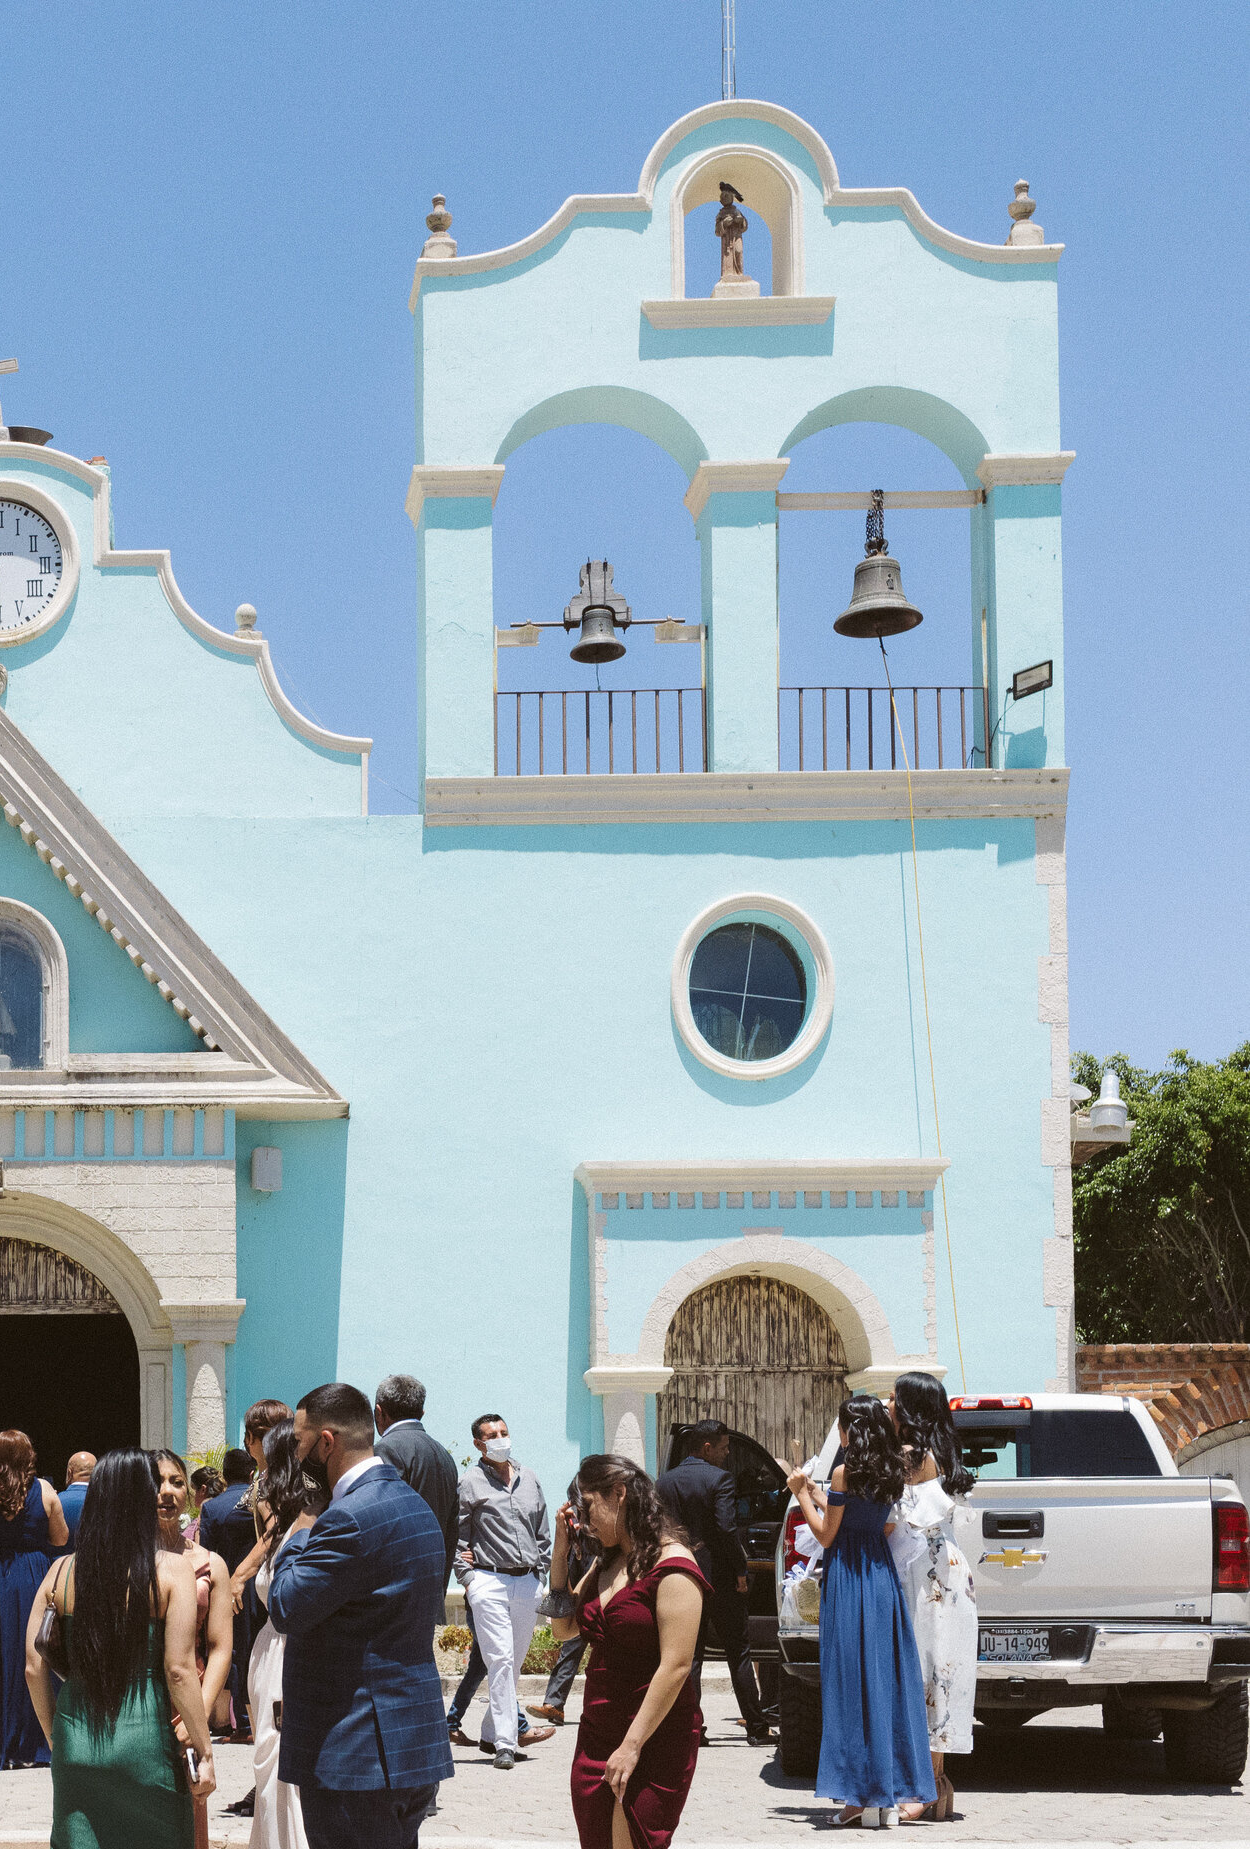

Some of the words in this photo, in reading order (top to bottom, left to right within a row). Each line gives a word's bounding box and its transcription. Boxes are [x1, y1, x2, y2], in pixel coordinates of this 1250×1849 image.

[29, 535, 38, 552] II
[39, 557, 51, 574] III
[27, 580, 43, 597] IIII
[15, 600, 24, 617] V
[981, 1637, 1049, 1652] JU-14-949
